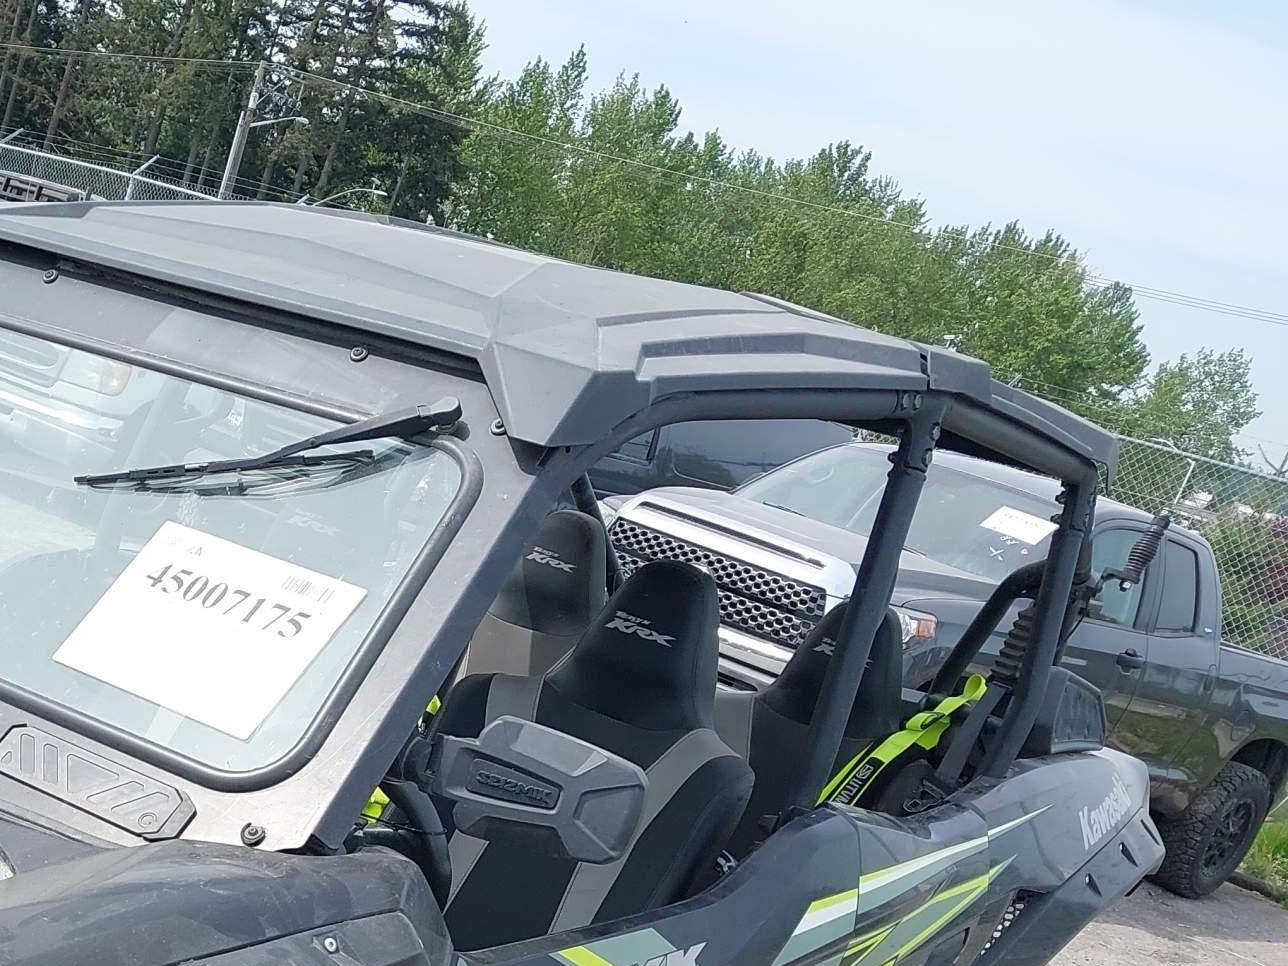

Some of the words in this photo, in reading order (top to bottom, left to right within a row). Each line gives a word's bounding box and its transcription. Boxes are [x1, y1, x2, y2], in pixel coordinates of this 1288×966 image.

[525, 552, 577, 574] KRX
[146, 564, 311, 638] 45007175
[605, 619, 677, 648] KRX
[475, 769, 553, 803] SEIZMIK
[1079, 773, 1131, 850] Kawasaki
